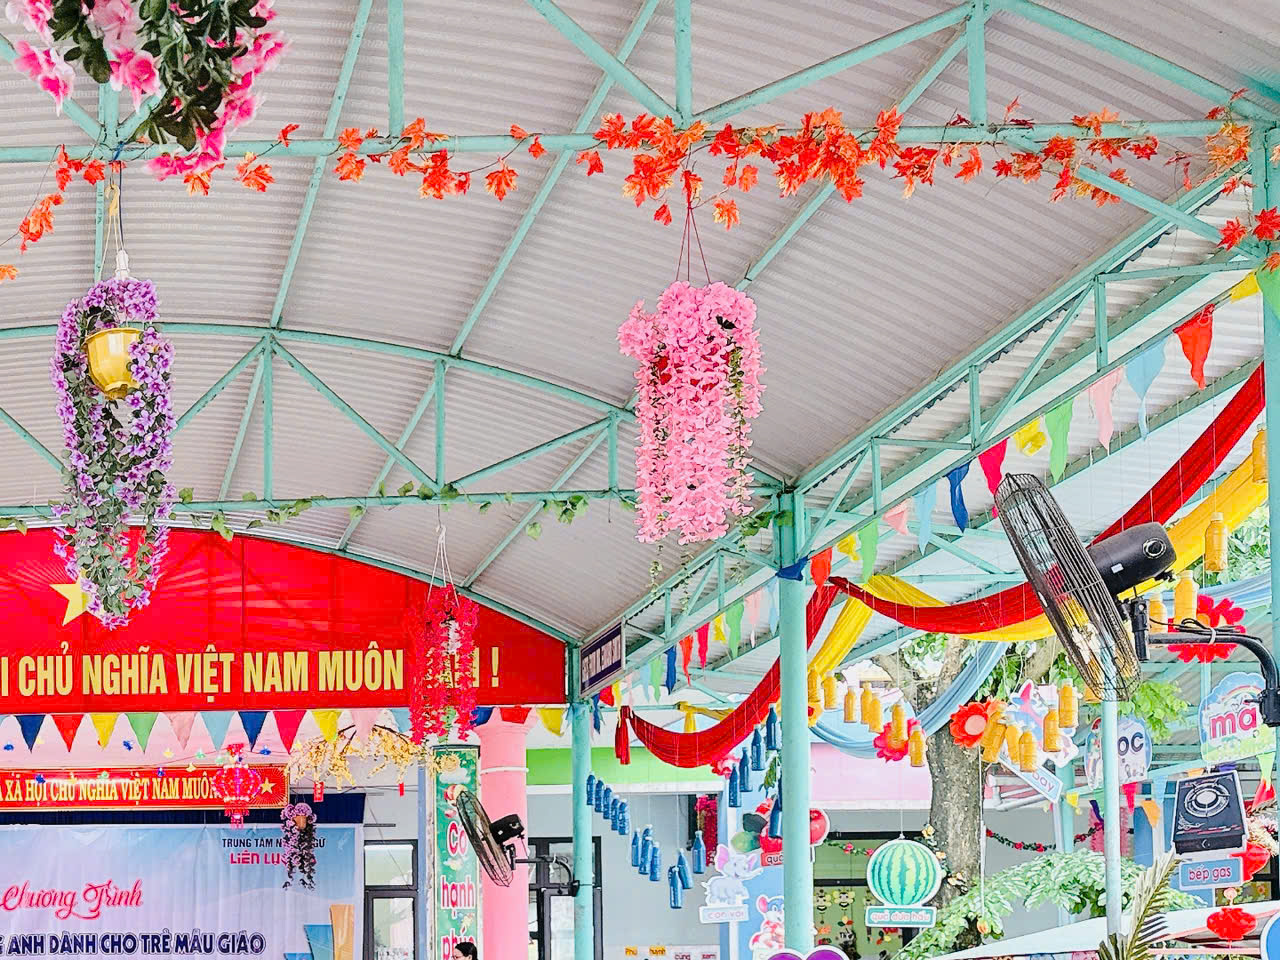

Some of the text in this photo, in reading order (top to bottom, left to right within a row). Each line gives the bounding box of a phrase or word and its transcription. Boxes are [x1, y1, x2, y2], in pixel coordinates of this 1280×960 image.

[18, 641, 74, 697] CHỦ
[82, 645, 168, 696] NGHĨA
[175, 643, 235, 703] VIỆT
[242, 651, 309, 693] NAM
[318, 640, 404, 692] MUÔN
[121, 772, 150, 806] VIỆT
[151, 777, 180, 800] NAM
[222, 838, 252, 848] TRUNG
[255, 837, 273, 848] TÂM
[264, 852, 284, 866] LỤ
[1188, 864, 1231, 882] bếp gas
[82, 877, 144, 914] Trình
[441, 875, 476, 918] hạnh
[6, 933, 46, 956] ANH
[48, 930, 98, 956] DÀNH
[100, 932, 138, 955] CHO
[140, 928, 172, 955] TRẺ
[173, 928, 215, 955] MẪU
[217, 930, 267, 955] GIÁO
